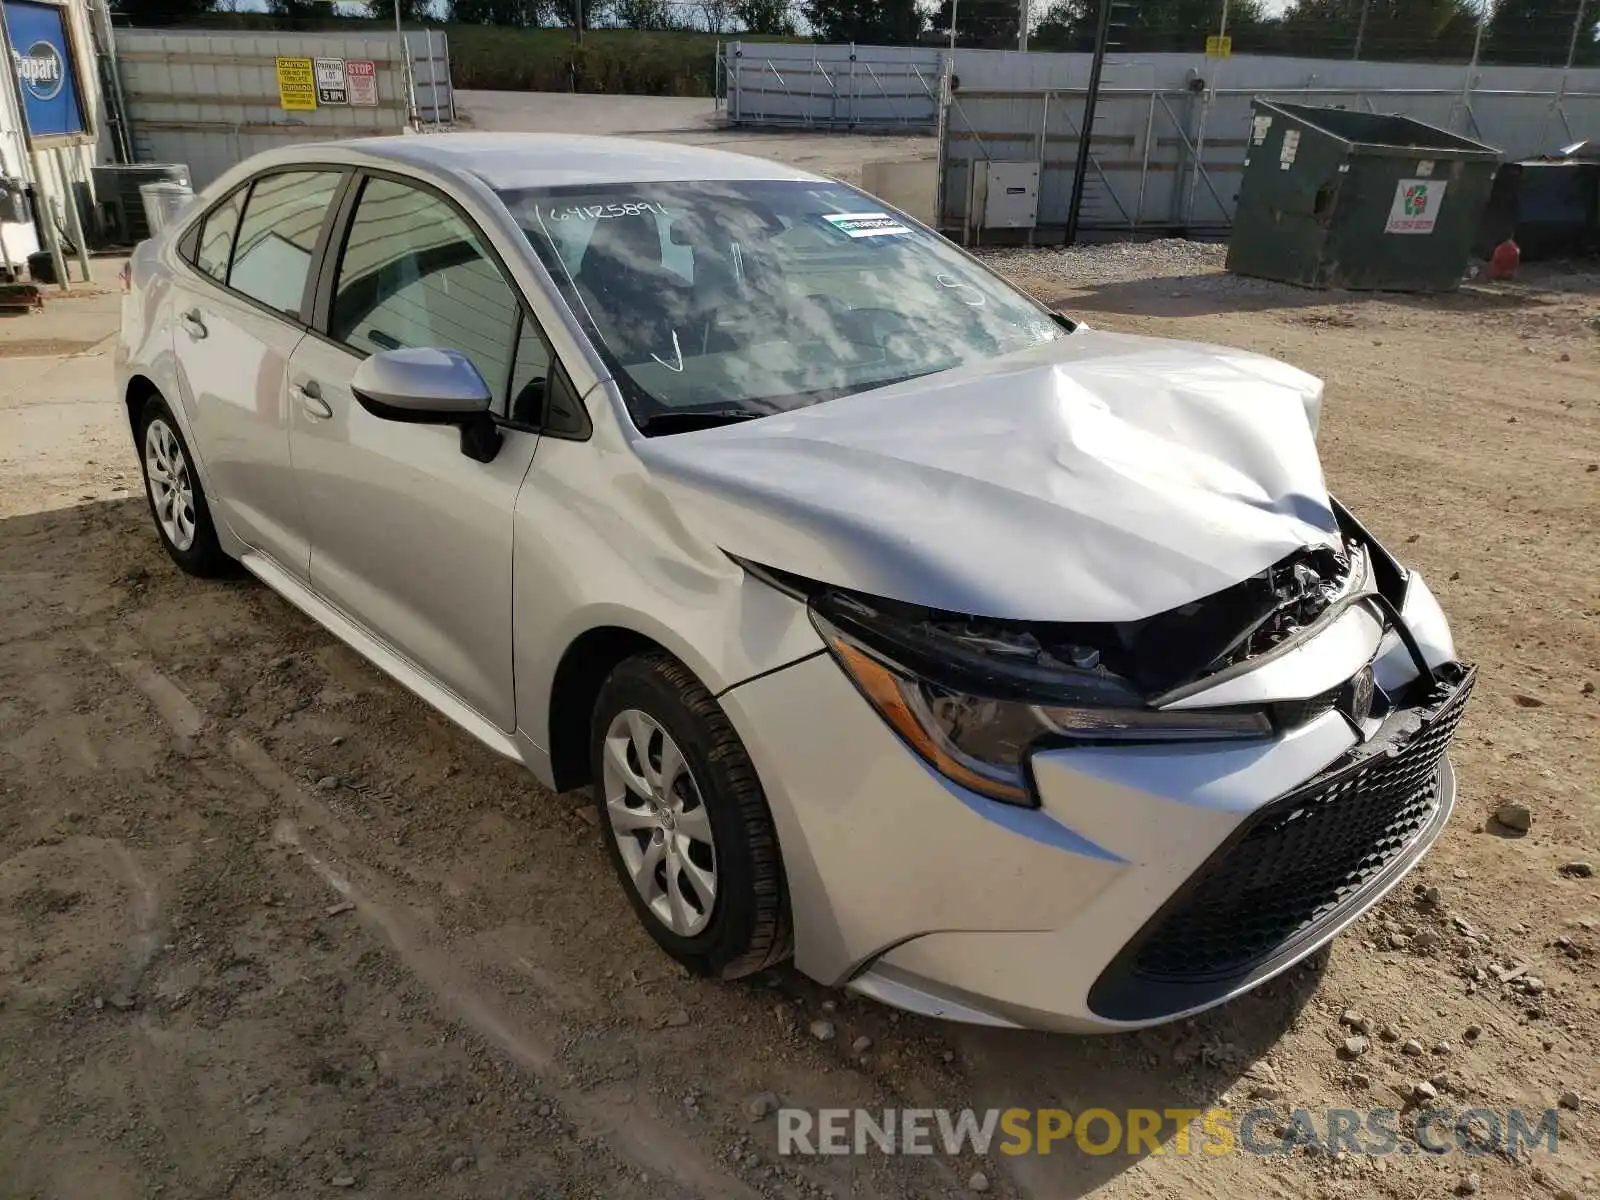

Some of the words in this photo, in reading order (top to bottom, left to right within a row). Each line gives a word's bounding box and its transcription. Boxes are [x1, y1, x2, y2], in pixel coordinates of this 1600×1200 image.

[279, 61, 309, 69] CAUTION
[317, 62, 342, 71] PARKING
[348, 63, 373, 75] STOP
[325, 71, 336, 80] LOT
[323, 91, 330, 100] 5
